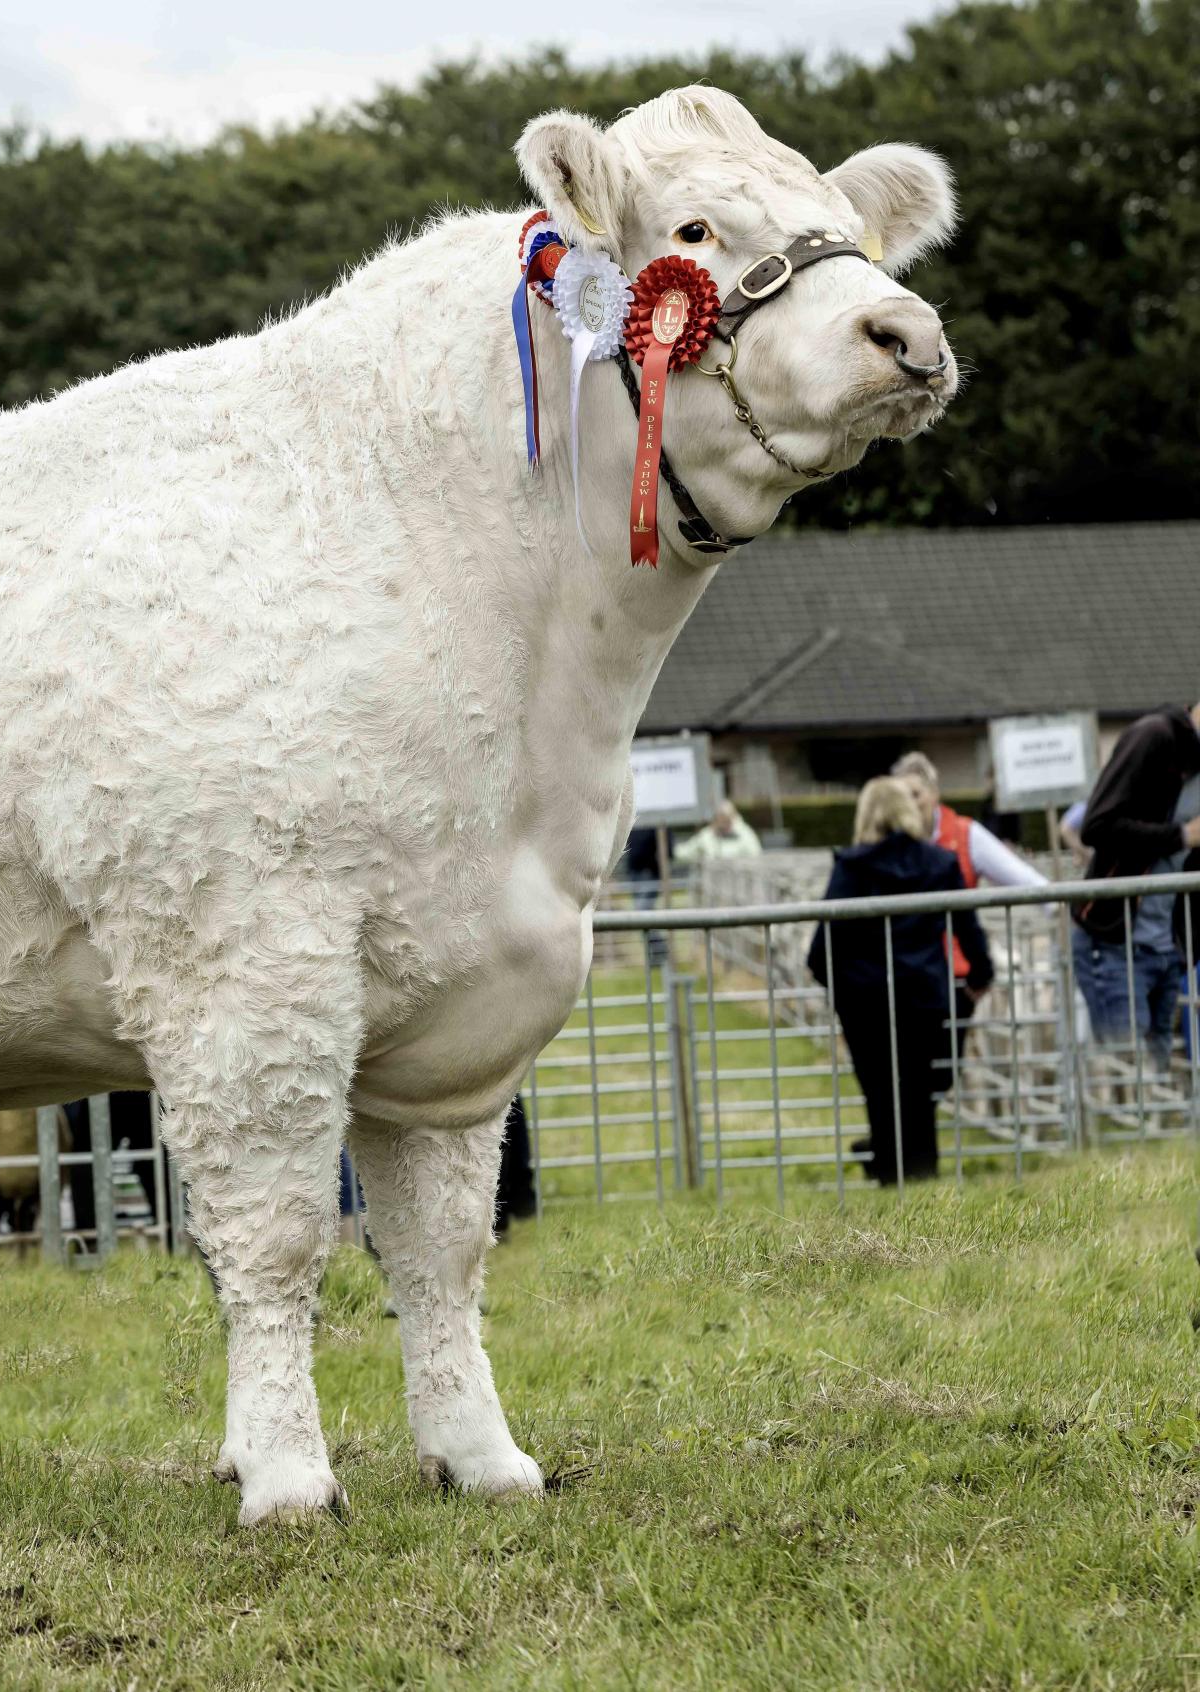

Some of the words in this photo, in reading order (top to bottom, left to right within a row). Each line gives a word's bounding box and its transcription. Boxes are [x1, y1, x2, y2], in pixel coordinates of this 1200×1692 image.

[664, 306, 679, 323] 1st
[647, 380, 658, 405] NEW
[646, 415, 655, 449] DEER
[639, 459, 651, 496] SHOW
